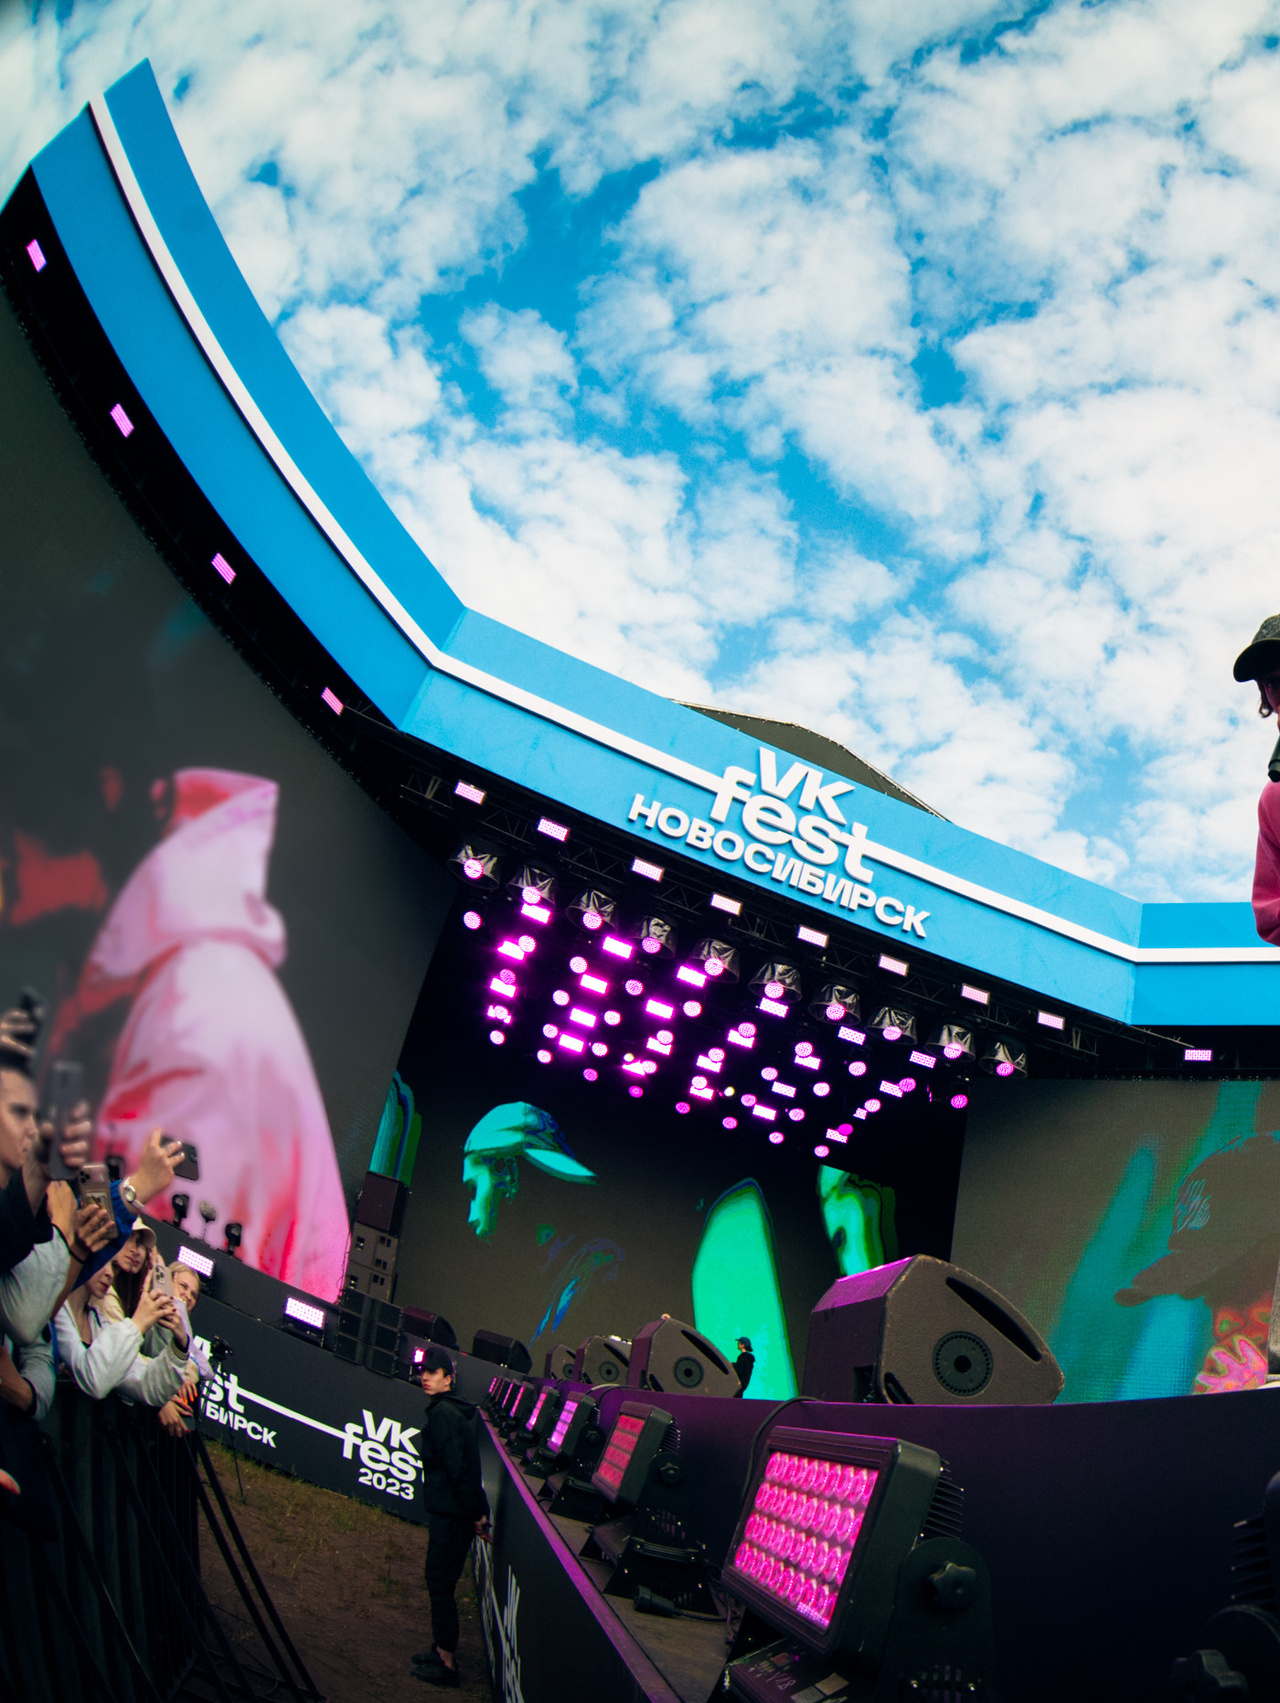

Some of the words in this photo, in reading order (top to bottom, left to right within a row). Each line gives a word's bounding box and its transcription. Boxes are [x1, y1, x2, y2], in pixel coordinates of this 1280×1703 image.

[759, 746, 856, 825] VK
[709, 765, 874, 884] fest
[628, 793, 931, 938] НОВОСИБИРСК
[202, 1373, 245, 1414] st
[362, 1408, 421, 1457] VK
[358, 1467, 415, 1501] 2023
